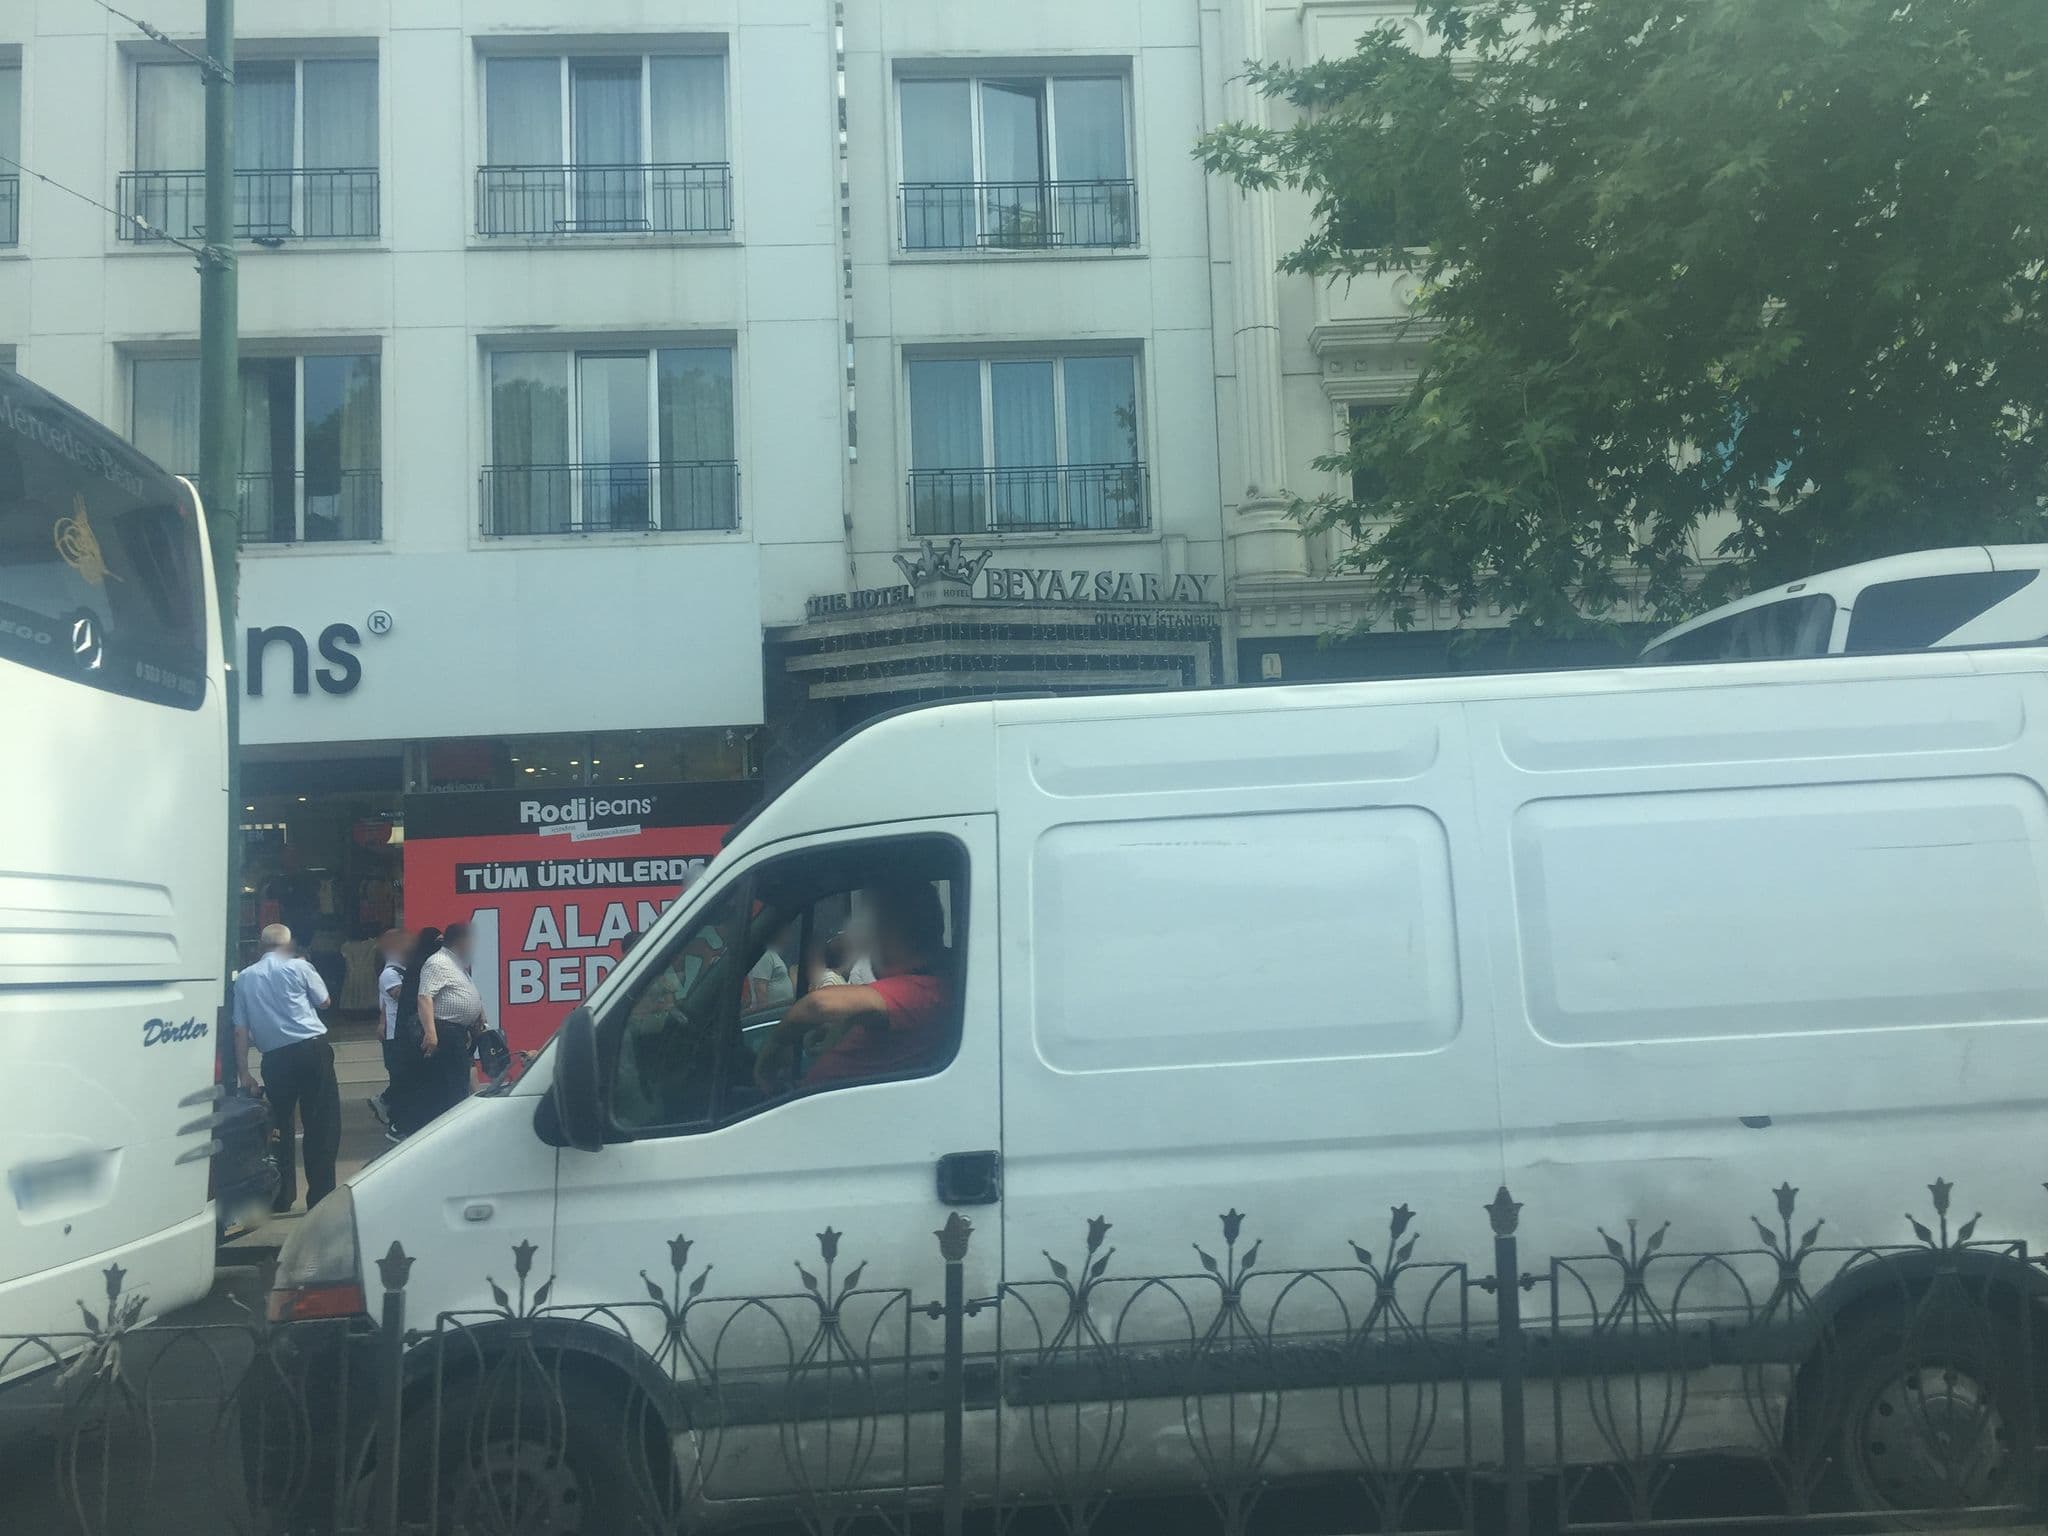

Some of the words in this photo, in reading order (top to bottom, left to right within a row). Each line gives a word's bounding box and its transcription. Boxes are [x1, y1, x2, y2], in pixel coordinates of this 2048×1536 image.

[849, 585, 913, 609] HOTEL
[943, 588, 971, 599] HOTEL
[1122, 613, 1152, 626] CITY
[463, 862, 529, 891] TÜM
[142, 1015, 209, 1048] Dörtler
